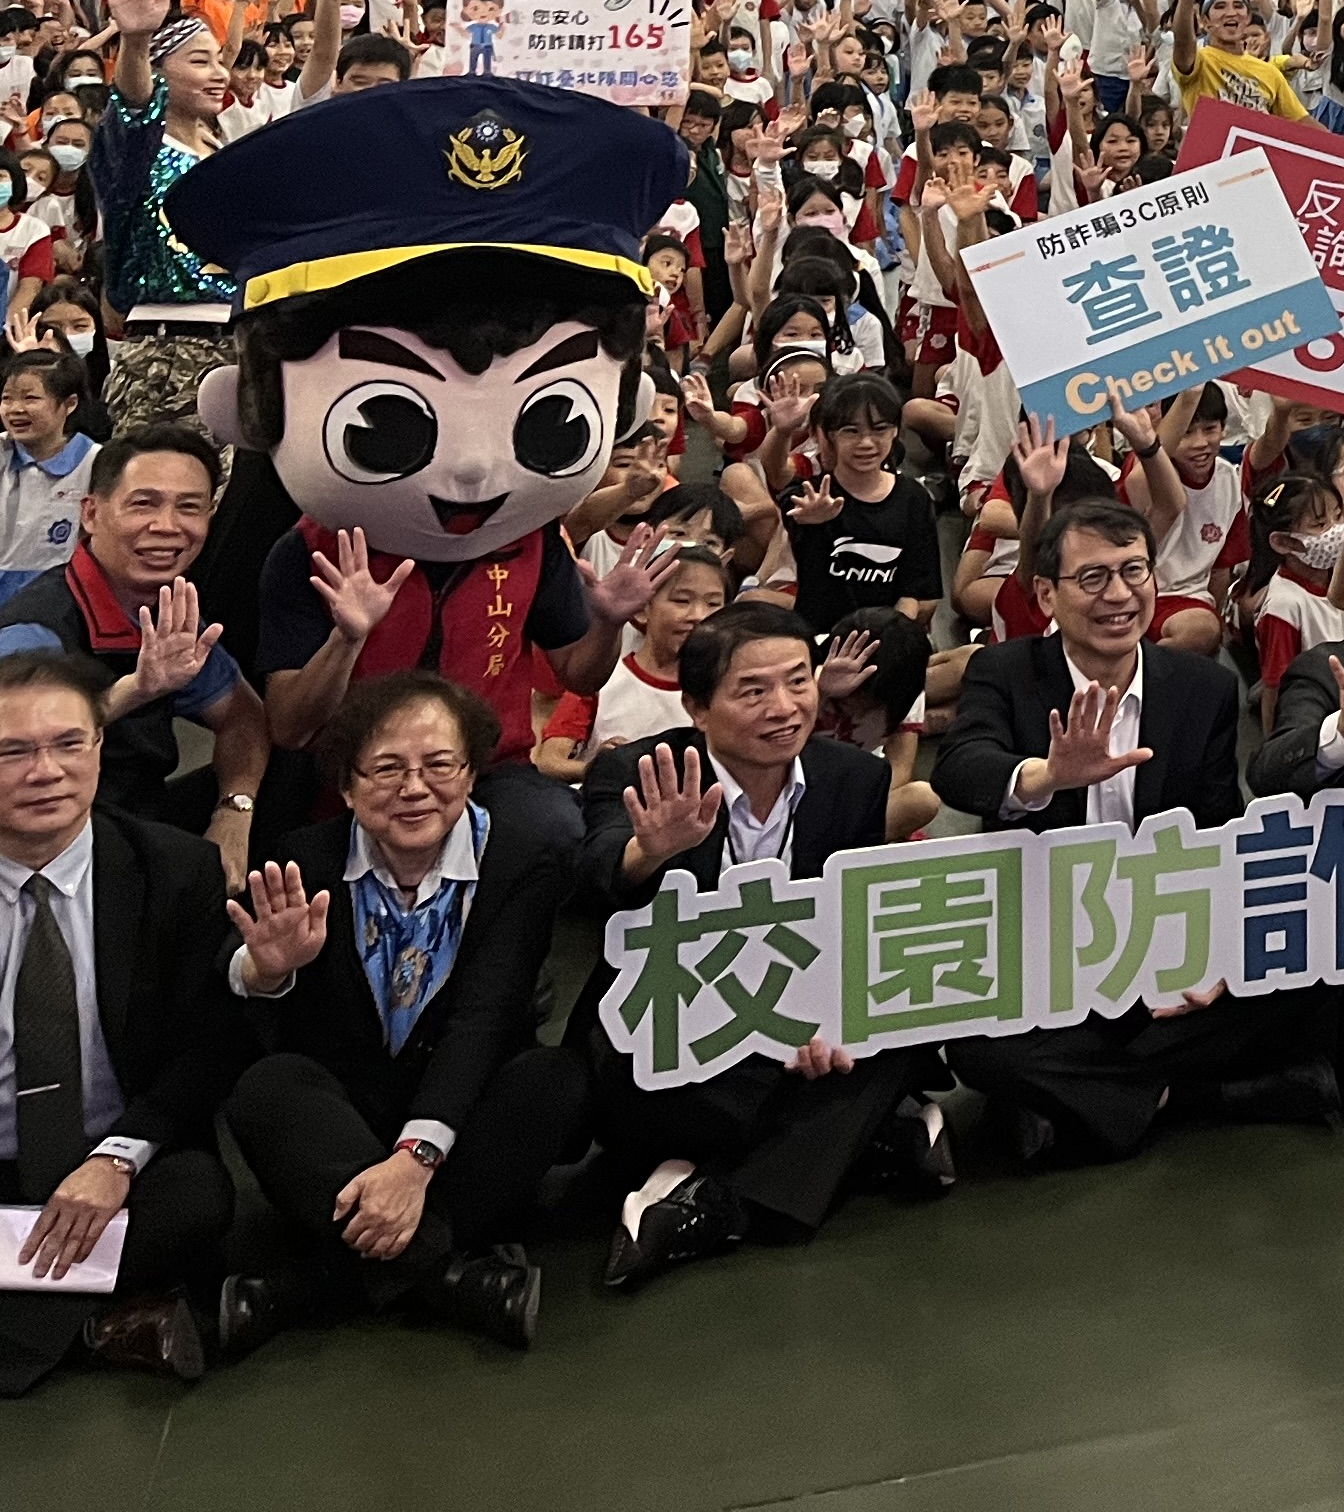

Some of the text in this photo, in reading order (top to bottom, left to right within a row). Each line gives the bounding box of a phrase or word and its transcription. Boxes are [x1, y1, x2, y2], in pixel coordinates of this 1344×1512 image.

[532, 10, 589, 25] 您安心
[1036, 181, 1210, 259] 防詐騙3C原則
[1062, 224, 1252, 345] 查證
[1065, 310, 1301, 415] Check it out
[482, 564, 513, 678] 中山分局
